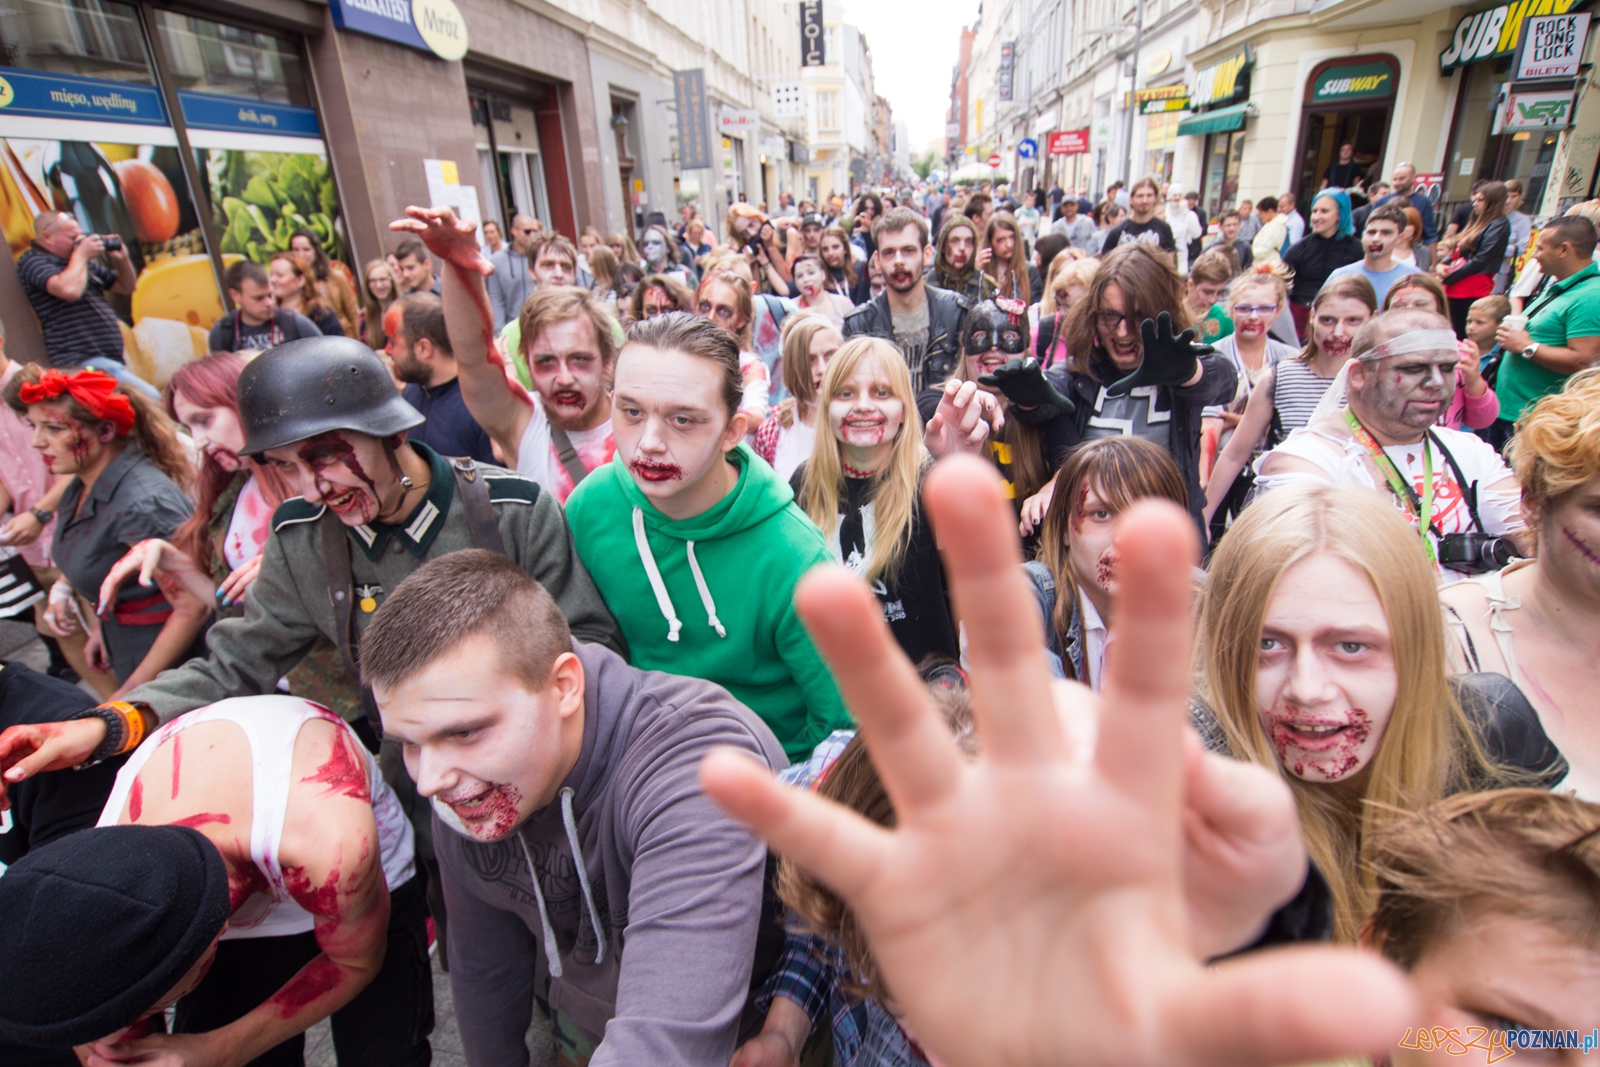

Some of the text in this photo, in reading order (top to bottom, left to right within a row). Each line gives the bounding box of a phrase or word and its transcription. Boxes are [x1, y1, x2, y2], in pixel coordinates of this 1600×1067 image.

[345, 0, 411, 25] IKATESY
[1441, 0, 1575, 66] SUBW
[1535, 16, 1577, 36] ROCK
[1535, 30, 1575, 49] LONG
[1533, 43, 1574, 62] LUCK
[1525, 66, 1569, 76] BILETY
[1319, 73, 1389, 96] SUBWAY
[50, 88, 137, 113] mięso, wędliny
